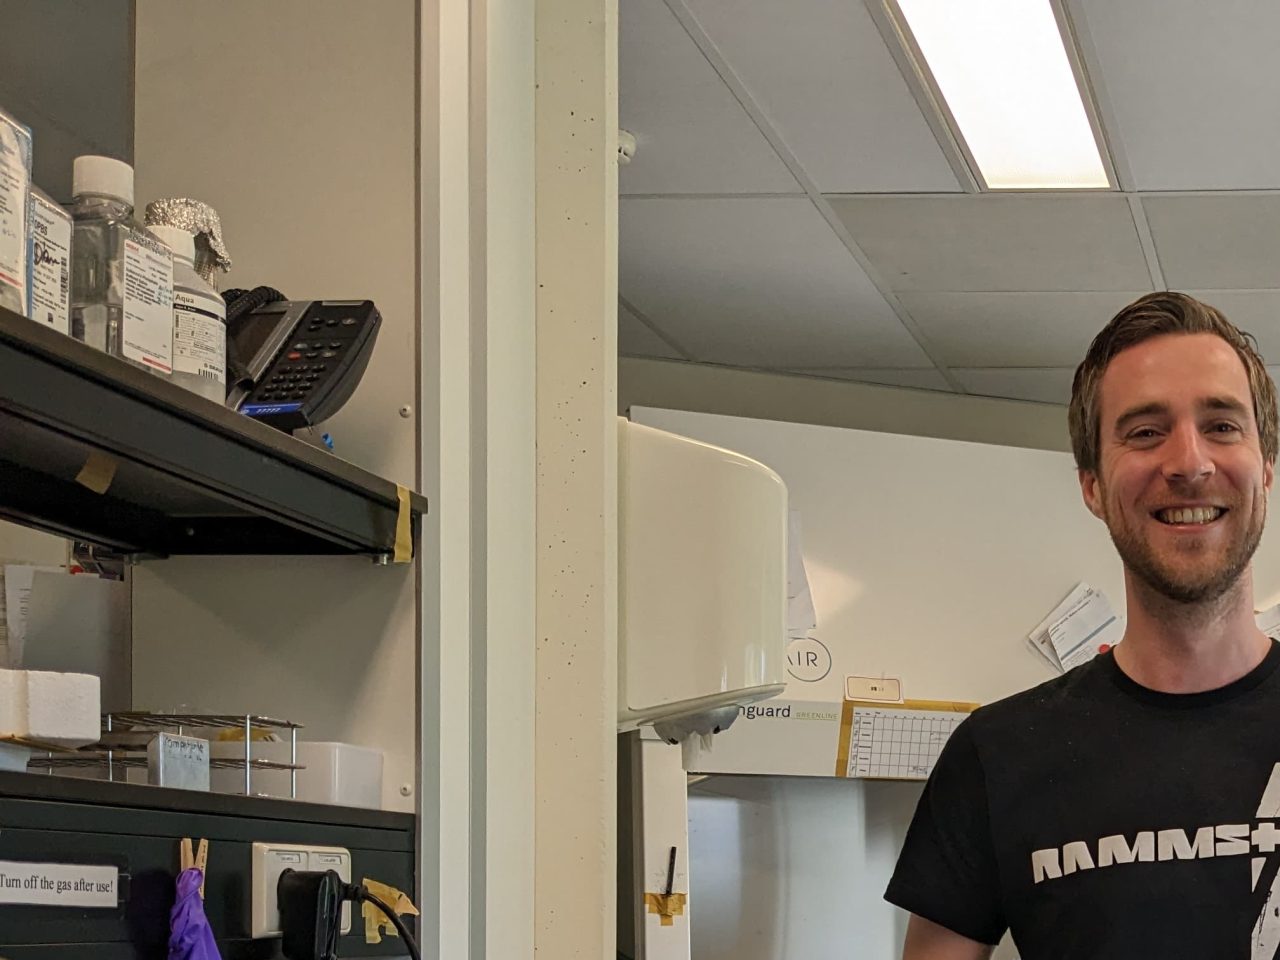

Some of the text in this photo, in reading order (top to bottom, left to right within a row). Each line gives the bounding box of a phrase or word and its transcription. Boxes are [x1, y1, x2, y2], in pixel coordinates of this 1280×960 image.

[175, 293, 195, 305] Aqua
[0, 874, 113, 893] Turn off the gas after use!
